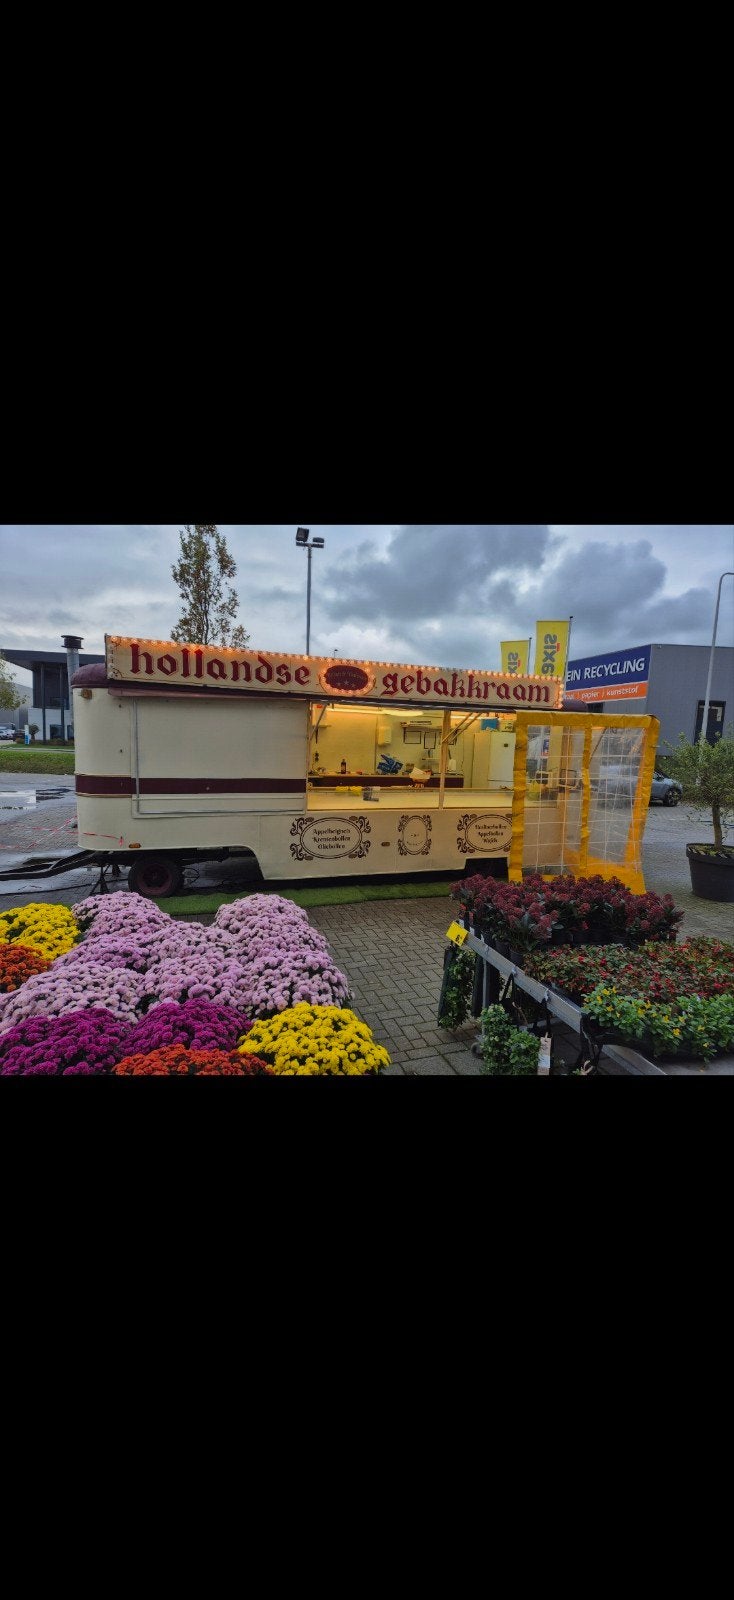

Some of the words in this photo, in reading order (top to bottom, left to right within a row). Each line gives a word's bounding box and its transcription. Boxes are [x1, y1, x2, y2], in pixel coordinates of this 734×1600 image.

[130, 643, 310, 686] hollandse
[380, 669, 550, 703] gebakkraam
[566, 669, 581, 682] EIN
[584, 658, 645, 679] RECYCLING
[606, 685, 639, 696] kunststof
